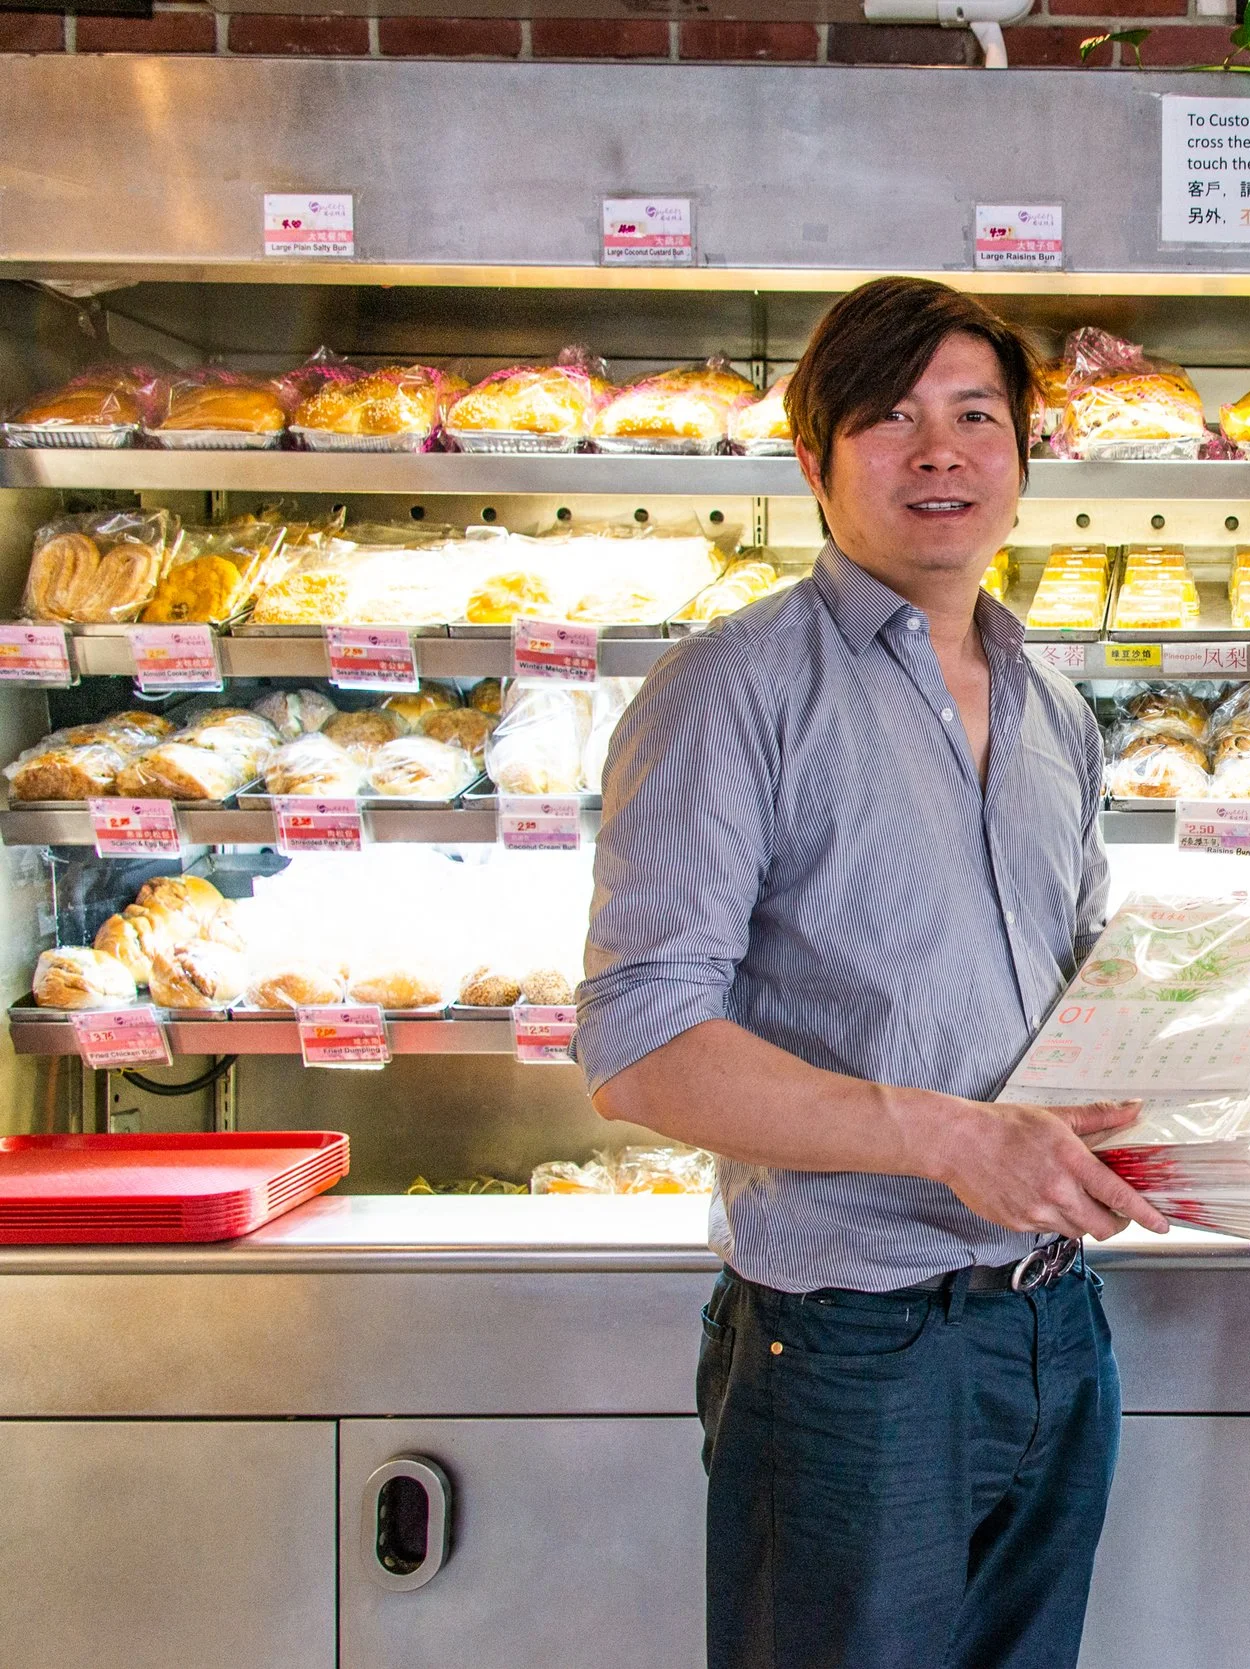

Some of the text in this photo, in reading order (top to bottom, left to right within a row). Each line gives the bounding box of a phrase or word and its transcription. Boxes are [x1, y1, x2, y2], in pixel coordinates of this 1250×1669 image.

[1187, 114, 1205, 127] To
[1187, 138, 1223, 149] cross
[1227, 135, 1249, 149] the
[1187, 157, 1227, 171] touch
[294, 243, 311, 251] Plain
[314, 243, 330, 252] Salty
[333, 243, 347, 251] Bun
[607, 249, 623, 257] Large
[981, 253, 1004, 261] Large
[1006, 253, 1036, 261] Raisins
[1041, 646, 1084, 667] 冬蓉
[1163, 647, 1247, 669] Pineapple 凤梨
[519, 662, 588, 676] Winter Melon Cake
[144, 841, 158, 849] Egg
[508, 843, 537, 851] Coconut
[538, 843, 561, 851] Cream
[1207, 847, 1250, 857] Raisins Bun
[1058, 1006, 1096, 1025] 01
[111, 1050, 141, 1058] Chicken
[142, 1048, 157, 1056] Bun
[344, 1047, 381, 1055] Dumpling
